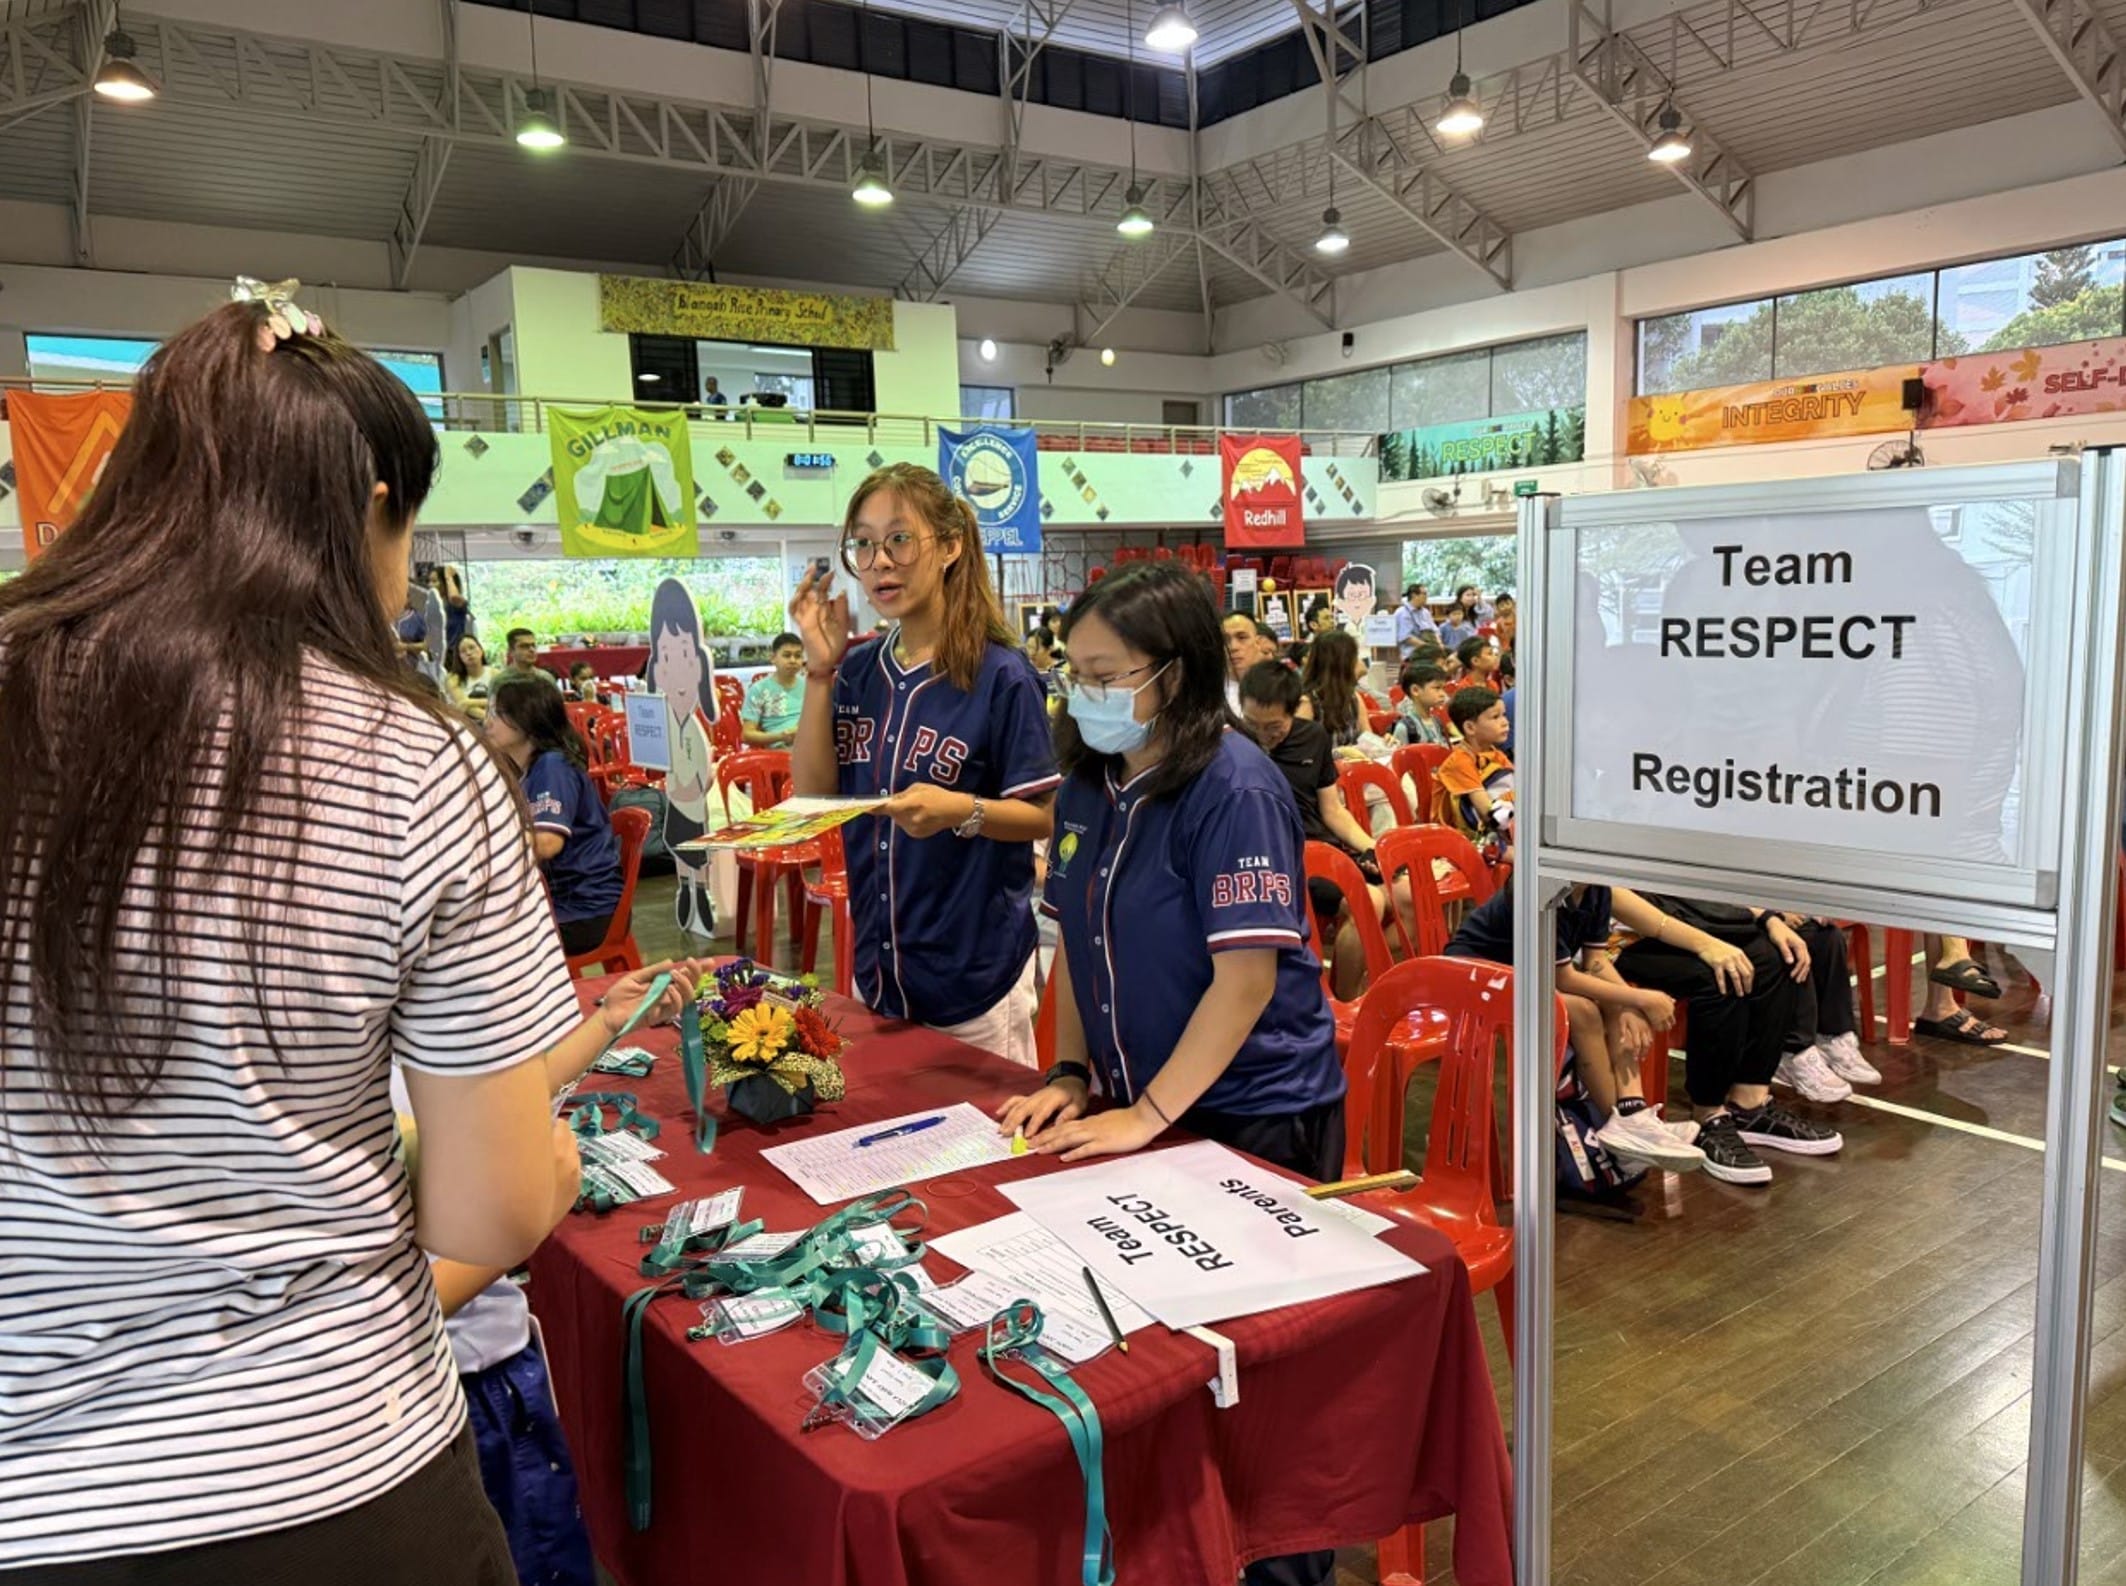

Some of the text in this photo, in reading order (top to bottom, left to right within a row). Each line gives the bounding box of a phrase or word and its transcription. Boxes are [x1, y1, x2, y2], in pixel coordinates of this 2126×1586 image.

[1722, 391, 1866, 428] INTEGRITY
[567, 421, 670, 457] GILLMAN
[1442, 431, 1537, 463] RESPECT
[1244, 509, 1286, 526] Redhill
[1713, 545, 1852, 586] Team
[1660, 615, 1916, 660] RESPECT
[1632, 752, 1941, 817] Registration
[1238, 856, 1269, 869] TEAM
[1212, 870, 1291, 908] BRPS
[1219, 1178, 1320, 1238] Parents
[1087, 1216, 1153, 1265] Team
[1106, 1193, 1234, 1271] RESPECT
